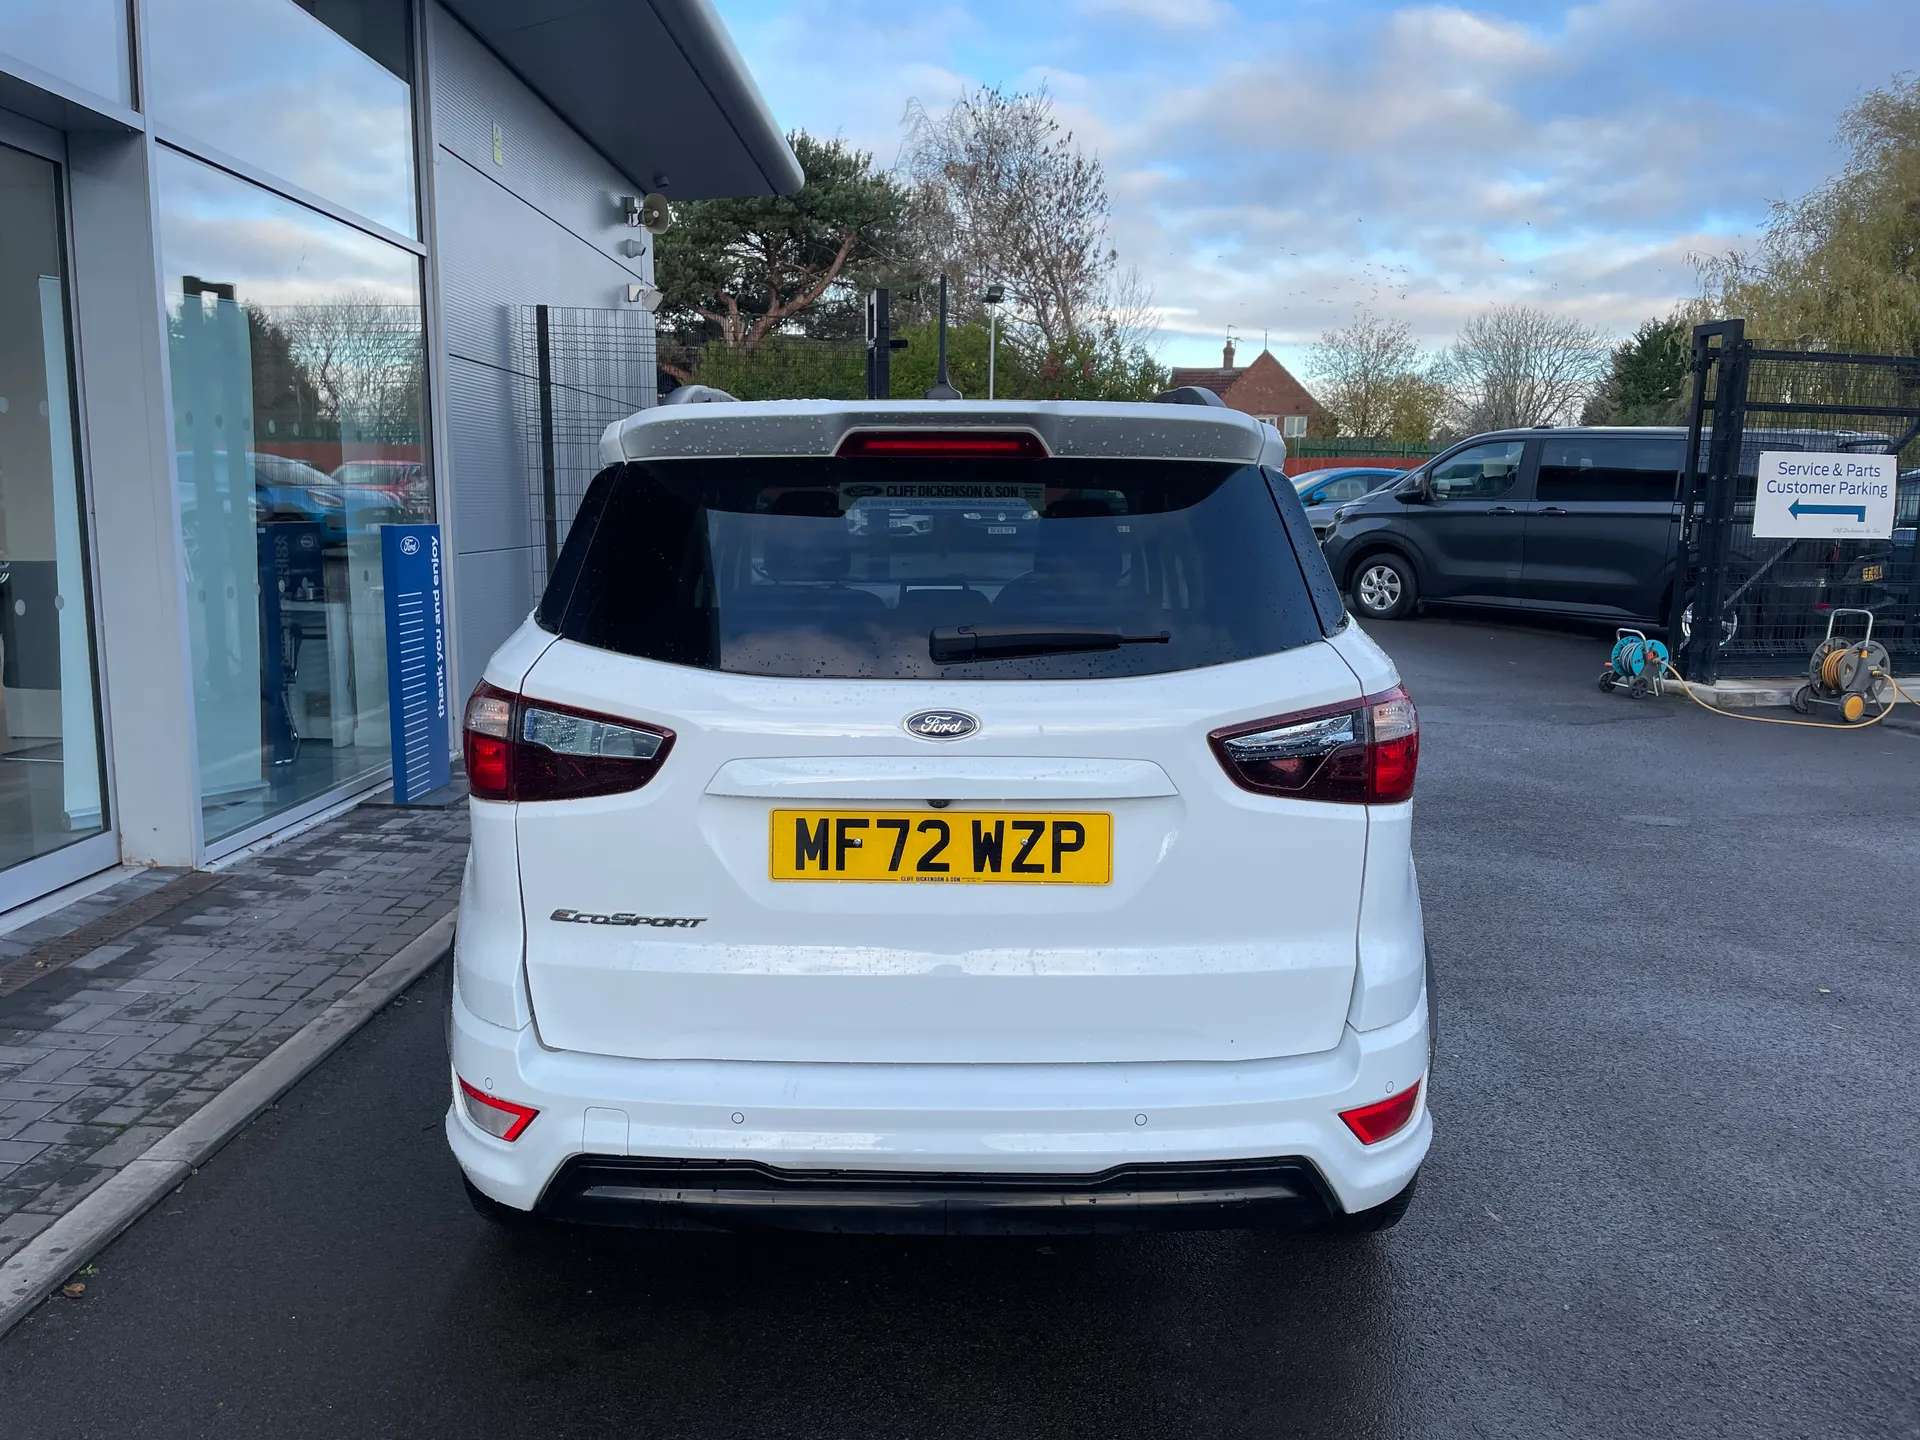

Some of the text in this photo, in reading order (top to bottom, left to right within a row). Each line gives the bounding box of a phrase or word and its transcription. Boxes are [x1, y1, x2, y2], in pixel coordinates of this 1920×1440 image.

[1778, 461, 1881, 477] Service & Parts
[886, 485, 918, 497] CLIFF
[918, 485, 982, 497] DICKENSON
[983, 486, 994, 497] &
[995, 486, 1019, 498] SON
[1766, 480, 1888, 498] Customer Parking
[431, 535, 445, 718] thank you and enjoy
[921, 715, 962, 733] Ford
[795, 817, 1086, 873] MF72 WZP
